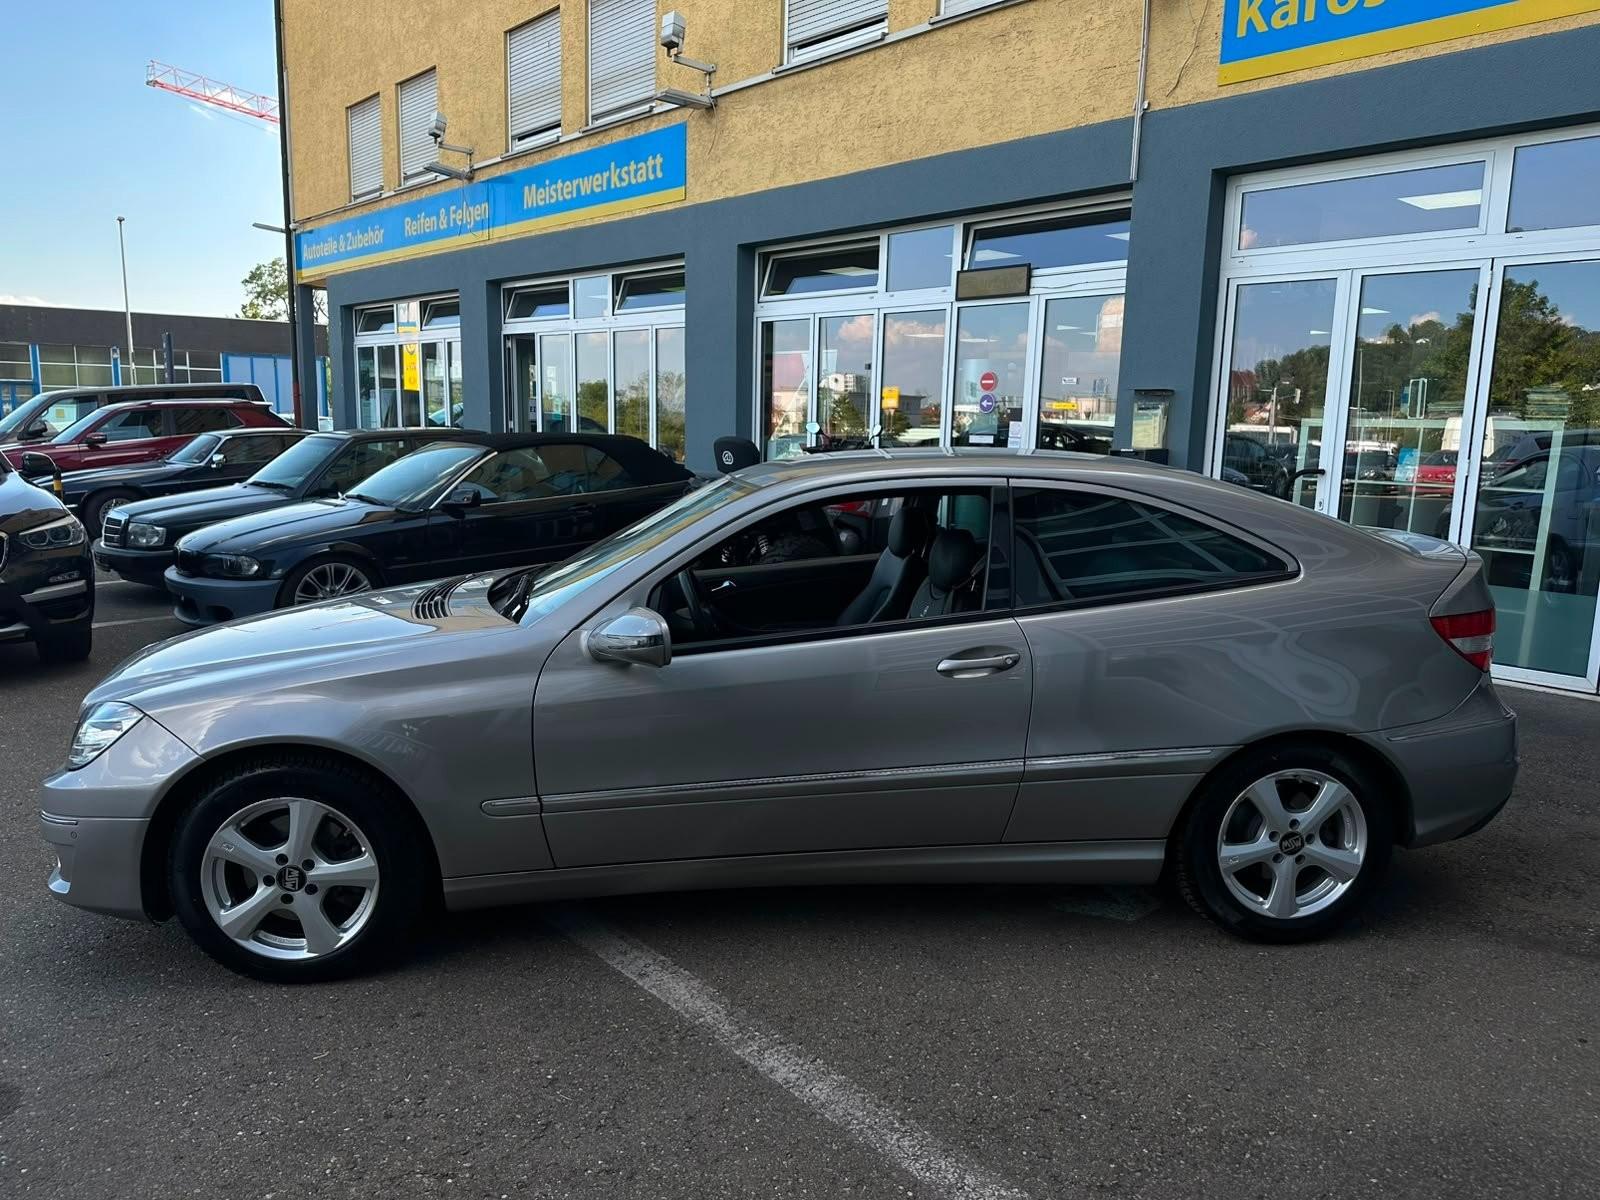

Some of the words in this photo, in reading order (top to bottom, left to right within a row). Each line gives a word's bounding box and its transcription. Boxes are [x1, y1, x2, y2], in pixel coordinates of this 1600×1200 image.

[1236, 0, 1386, 38] Kar
[303, 237, 338, 261] Autoteile
[339, 236, 346, 252] &
[346, 226, 385, 251] Zubehör
[404, 212, 437, 238] Reifen
[439, 207, 448, 230] &
[450, 201, 489, 230] Felgen
[523, 153, 663, 209] Meisterwerkstatt
[1281, 835, 1303, 853] MSW
